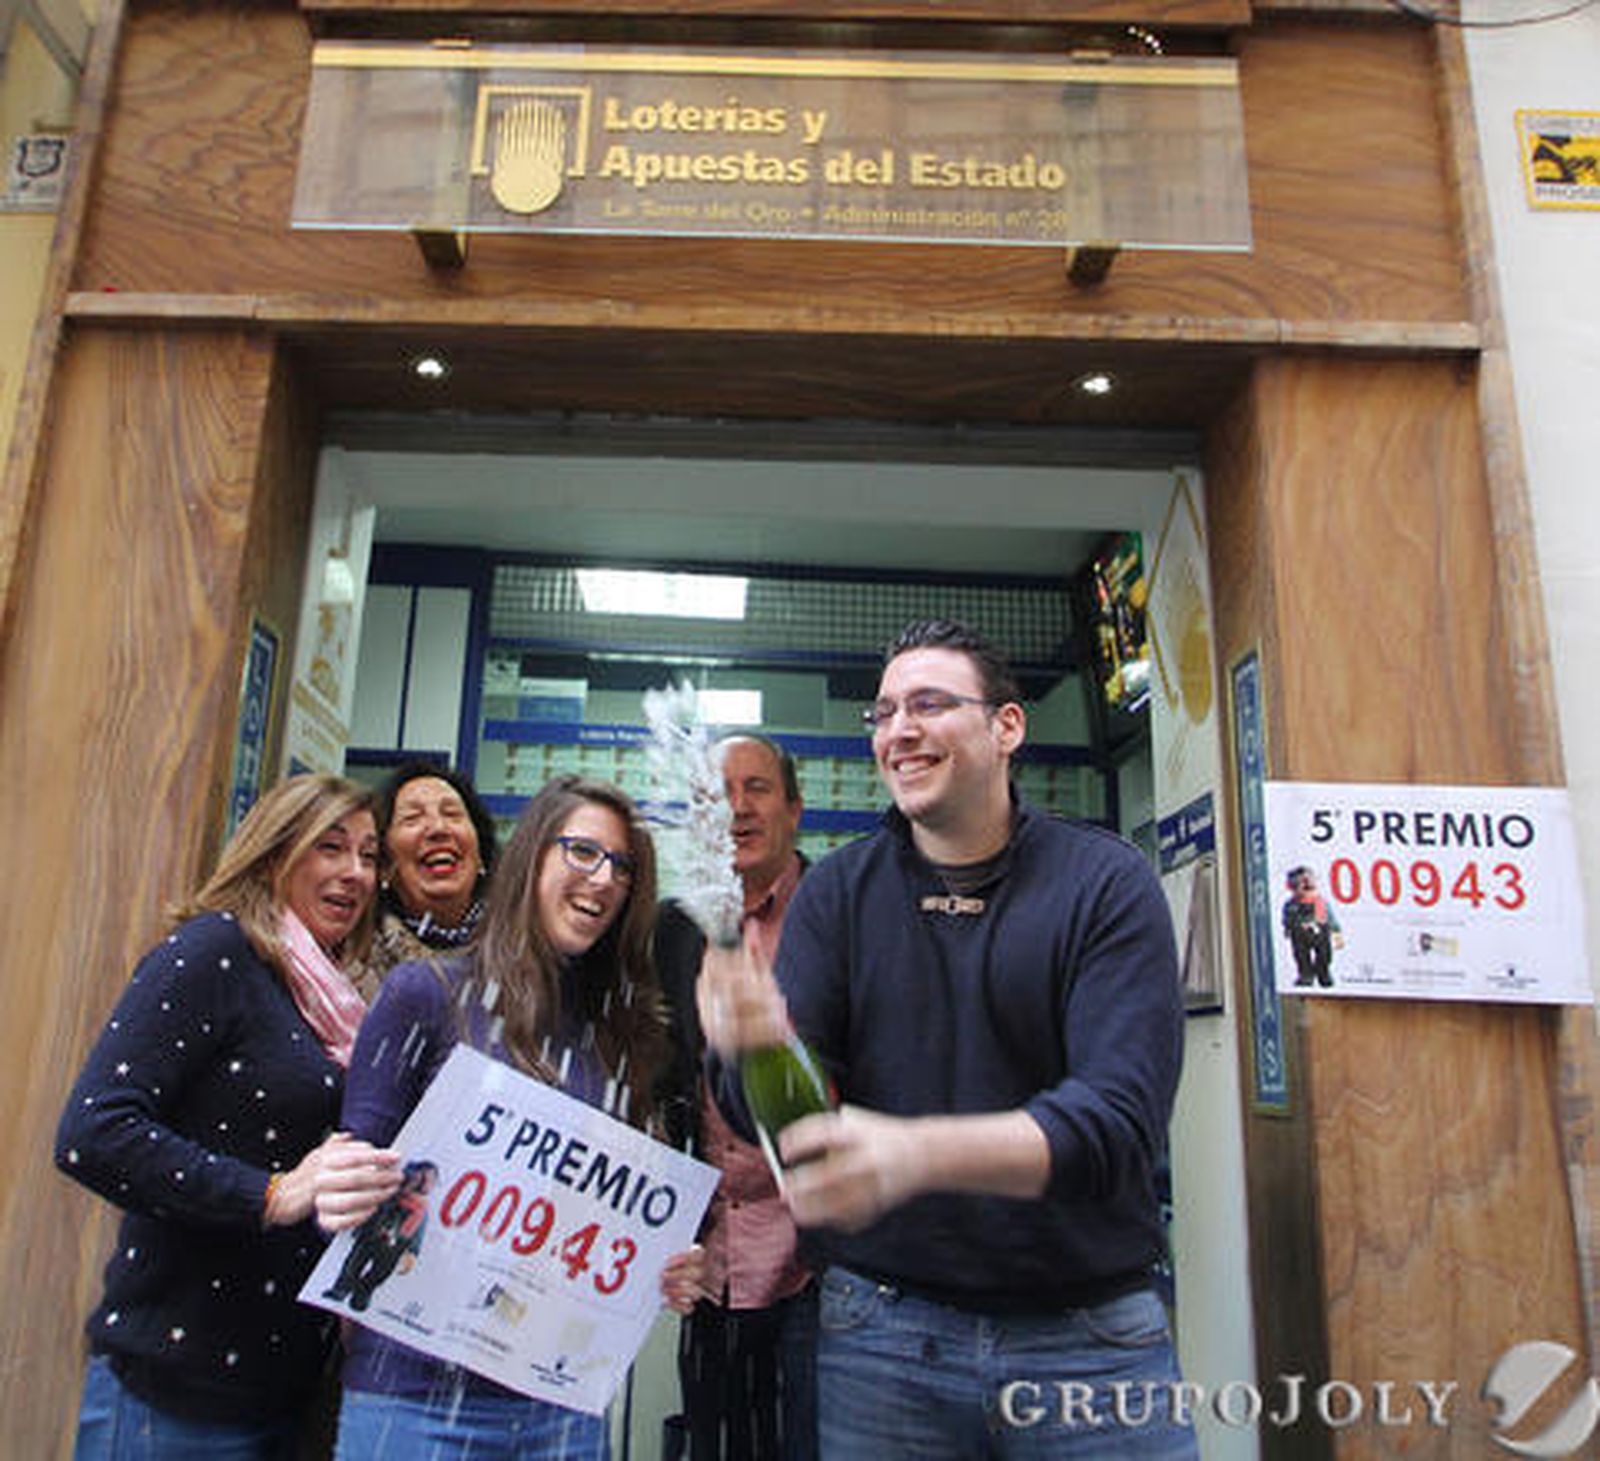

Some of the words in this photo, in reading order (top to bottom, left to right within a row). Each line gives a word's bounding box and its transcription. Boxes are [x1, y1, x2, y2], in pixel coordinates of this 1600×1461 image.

[802, 110, 827, 144] y
[600, 146, 810, 187] Apuestas
[825, 151, 894, 185] del
[909, 152, 1066, 189] Estado
[1353, 811, 1534, 849] PREMIO
[1329, 858, 1526, 910] 00943
[505, 1118, 679, 1228] PREMIO
[440, 1170, 638, 1295] 00943
